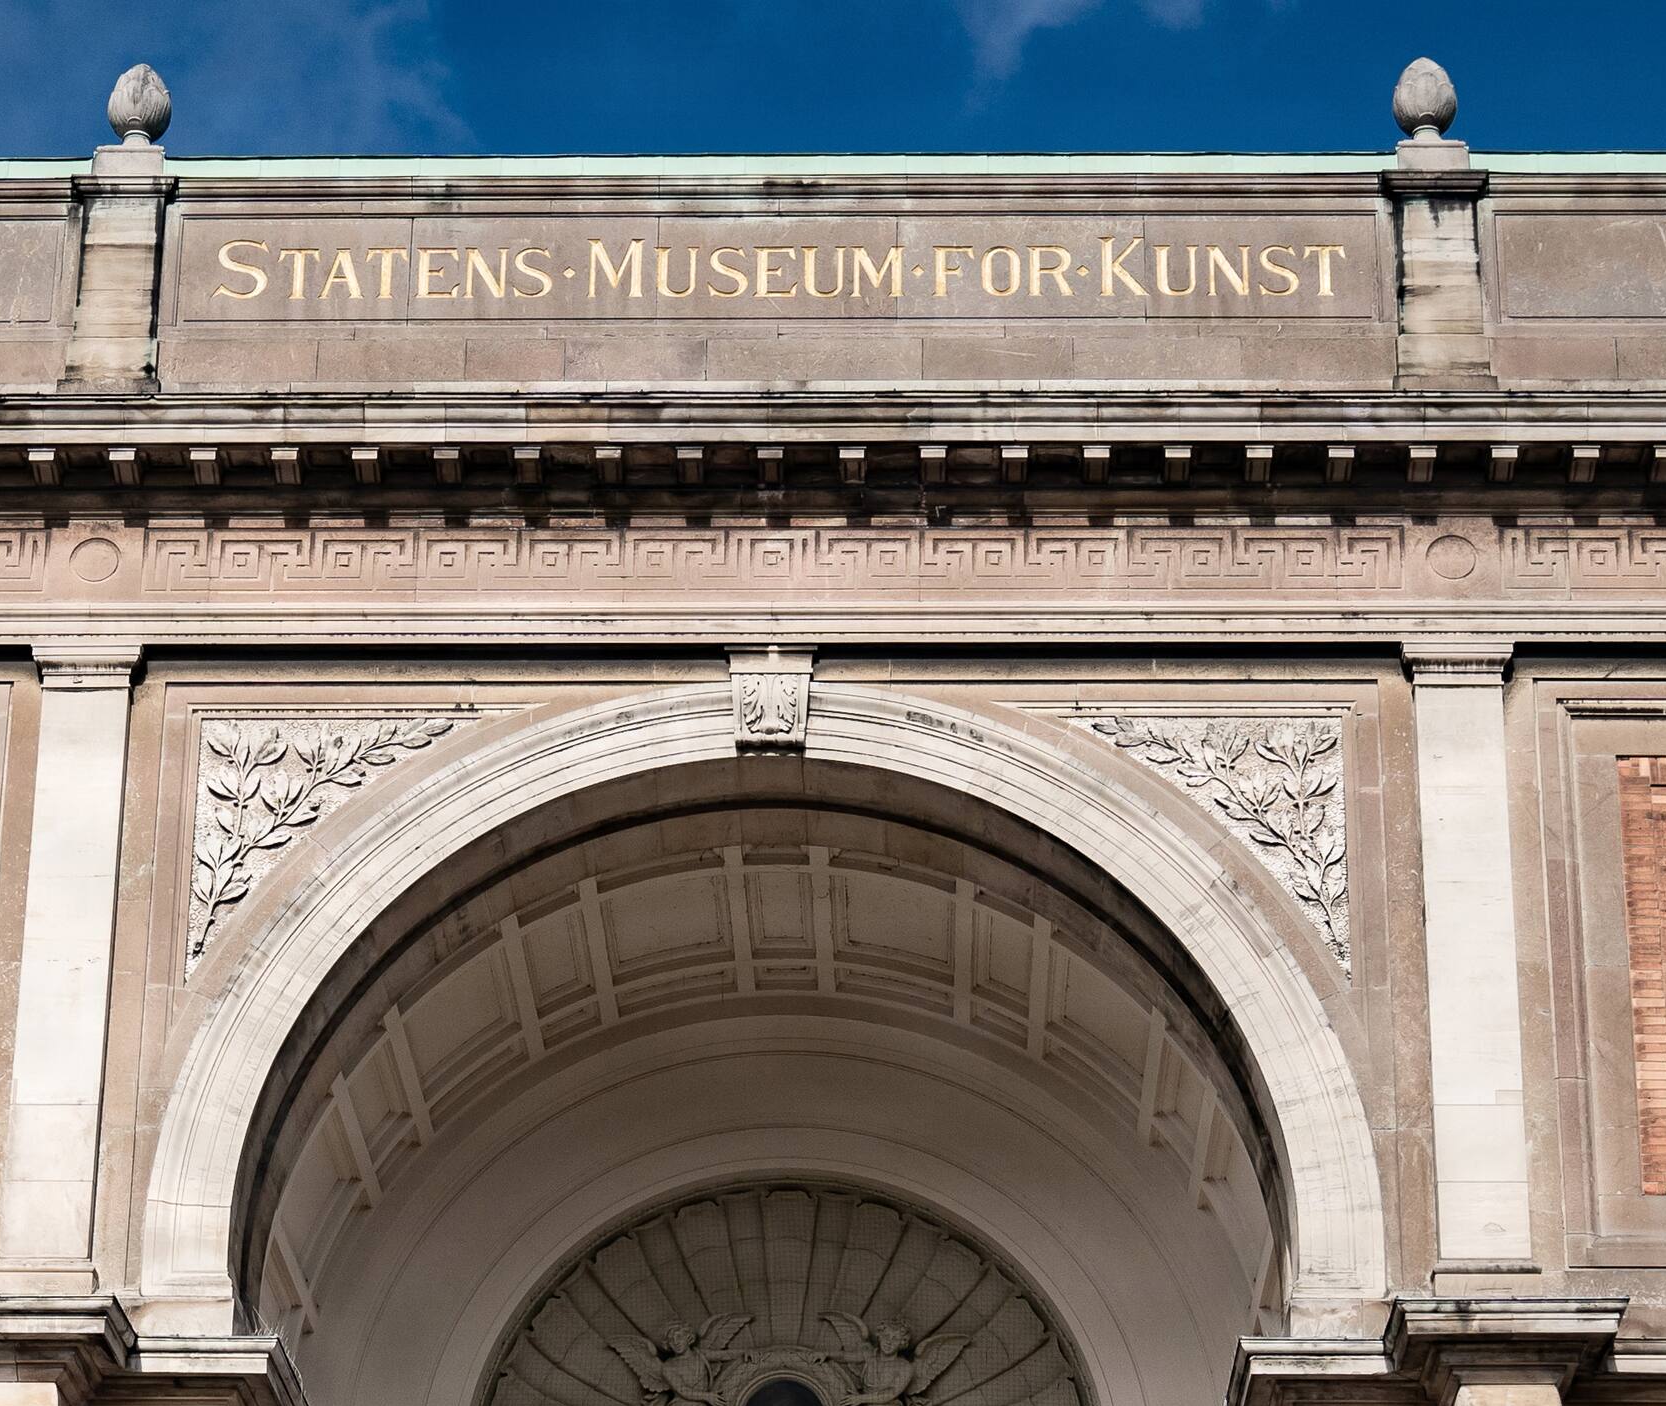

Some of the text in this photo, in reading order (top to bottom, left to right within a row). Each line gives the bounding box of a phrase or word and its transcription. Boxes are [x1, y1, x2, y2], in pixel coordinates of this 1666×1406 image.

[210, 235, 1346, 299] STATENS MUSEUM FOR KUNST
